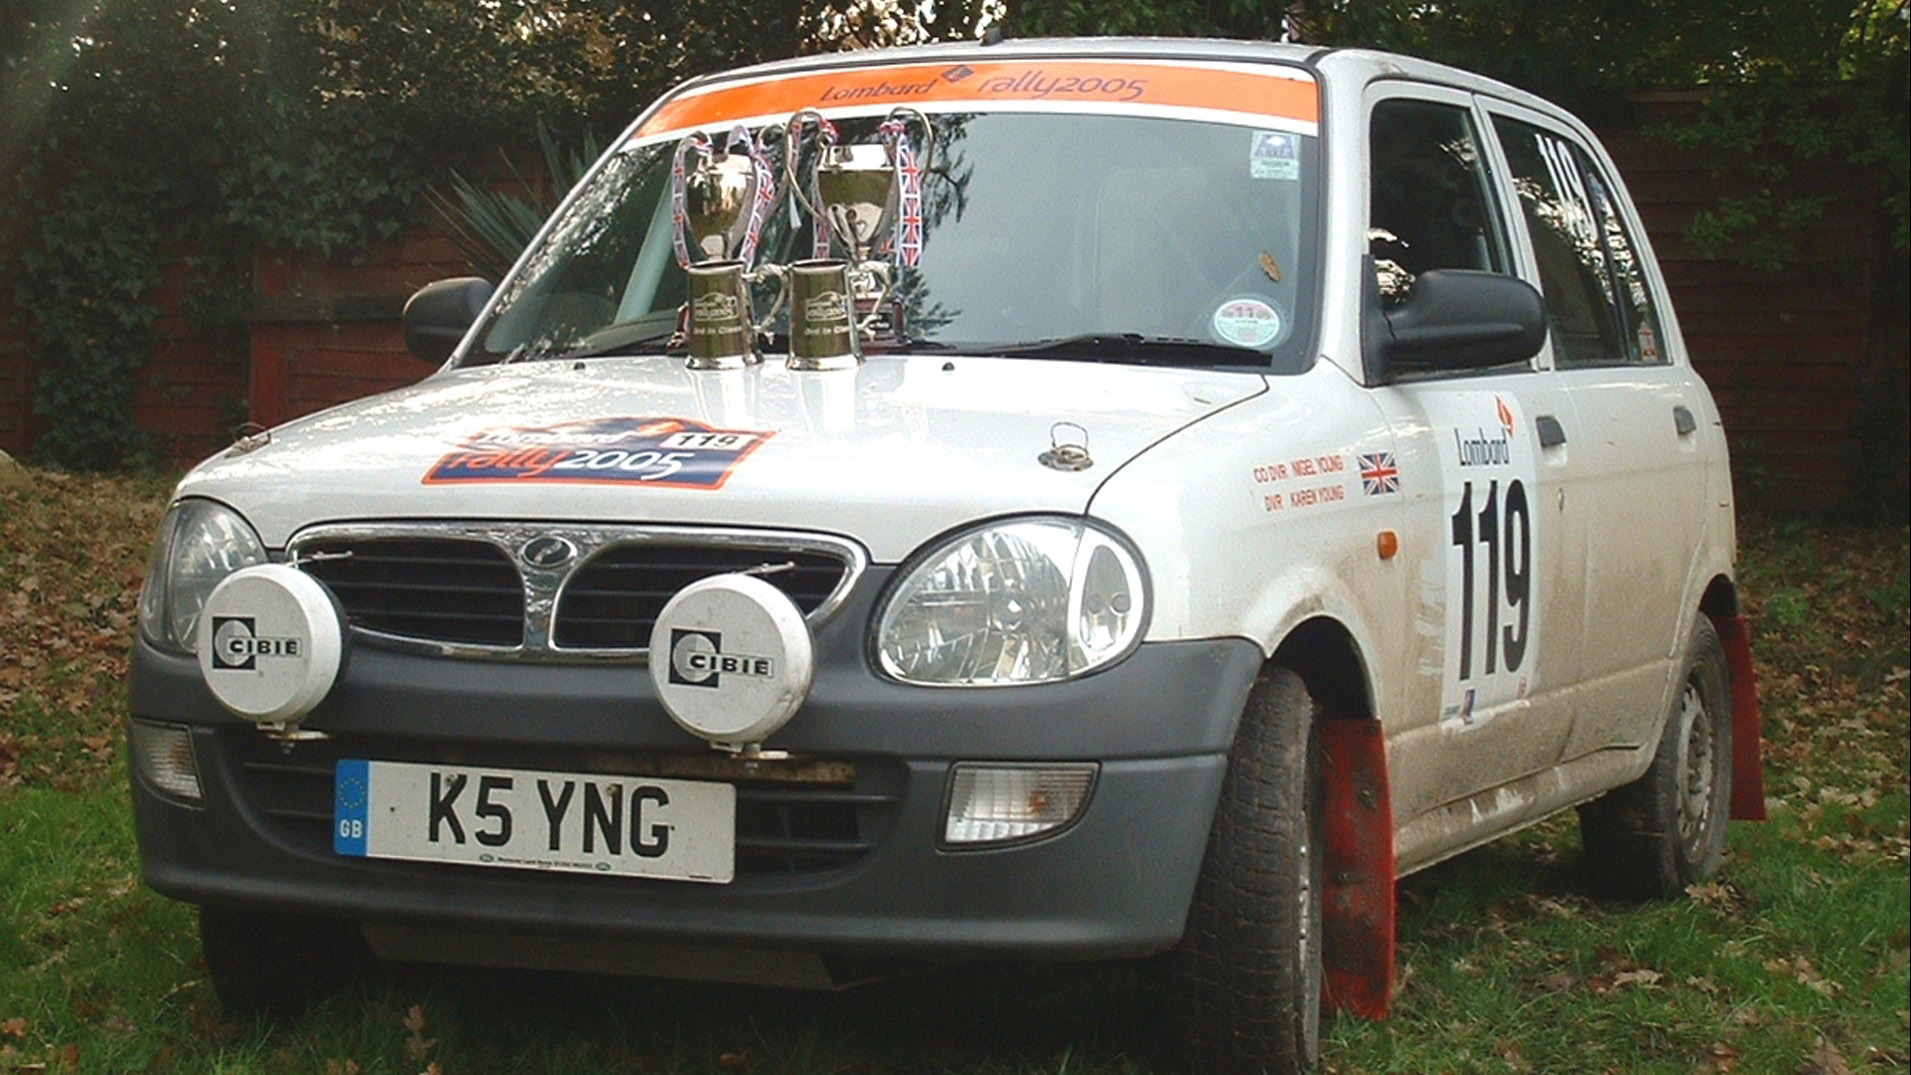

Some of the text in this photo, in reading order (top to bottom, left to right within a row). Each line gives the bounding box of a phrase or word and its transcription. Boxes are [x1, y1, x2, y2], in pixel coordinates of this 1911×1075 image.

[820, 70, 1149, 101] Lombard rally2005
[679, 434, 740, 448] 119
[1454, 427, 1509, 467] Lombard
[447, 450, 695, 481] rally2005
[1291, 458, 1317, 477] NIGEL
[1316, 455, 1344, 474] YOUNG
[1290, 488, 1318, 507] KAREN
[1452, 479, 1530, 680] 119
[229, 639, 298, 655] CIBIE
[689, 654, 770, 676] CIBIE
[428, 772, 671, 859] K5 YNG
[340, 819, 364, 839] GB
